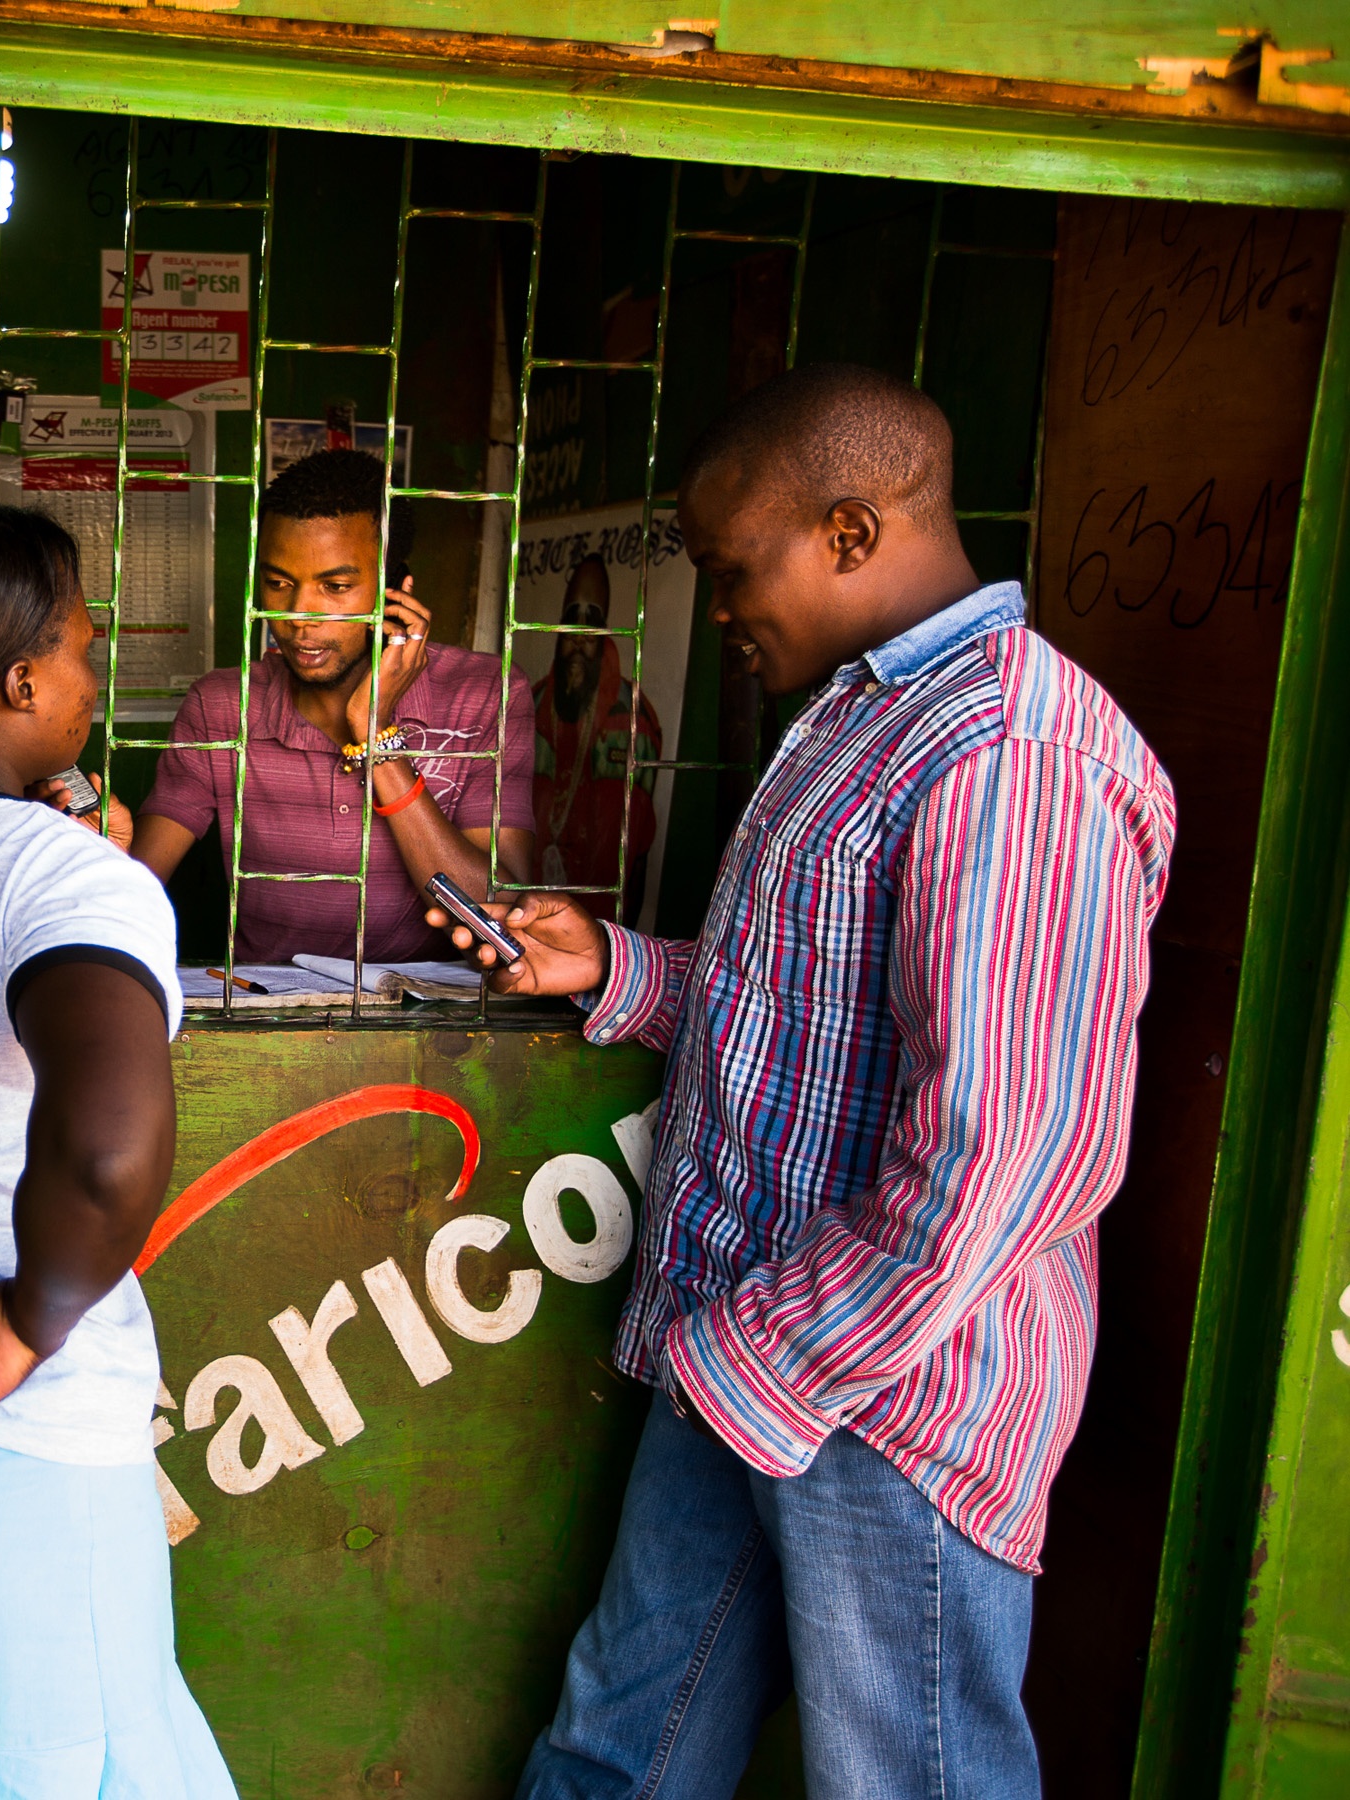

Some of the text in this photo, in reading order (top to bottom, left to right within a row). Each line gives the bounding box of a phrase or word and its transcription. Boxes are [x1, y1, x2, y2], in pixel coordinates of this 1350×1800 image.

[132, 311, 220, 329] Agent number
[122, 418, 162, 429] ARIFFS
[69, 429, 106, 438] EFFECTIVE
[153, 1098, 660, 1547] arico
